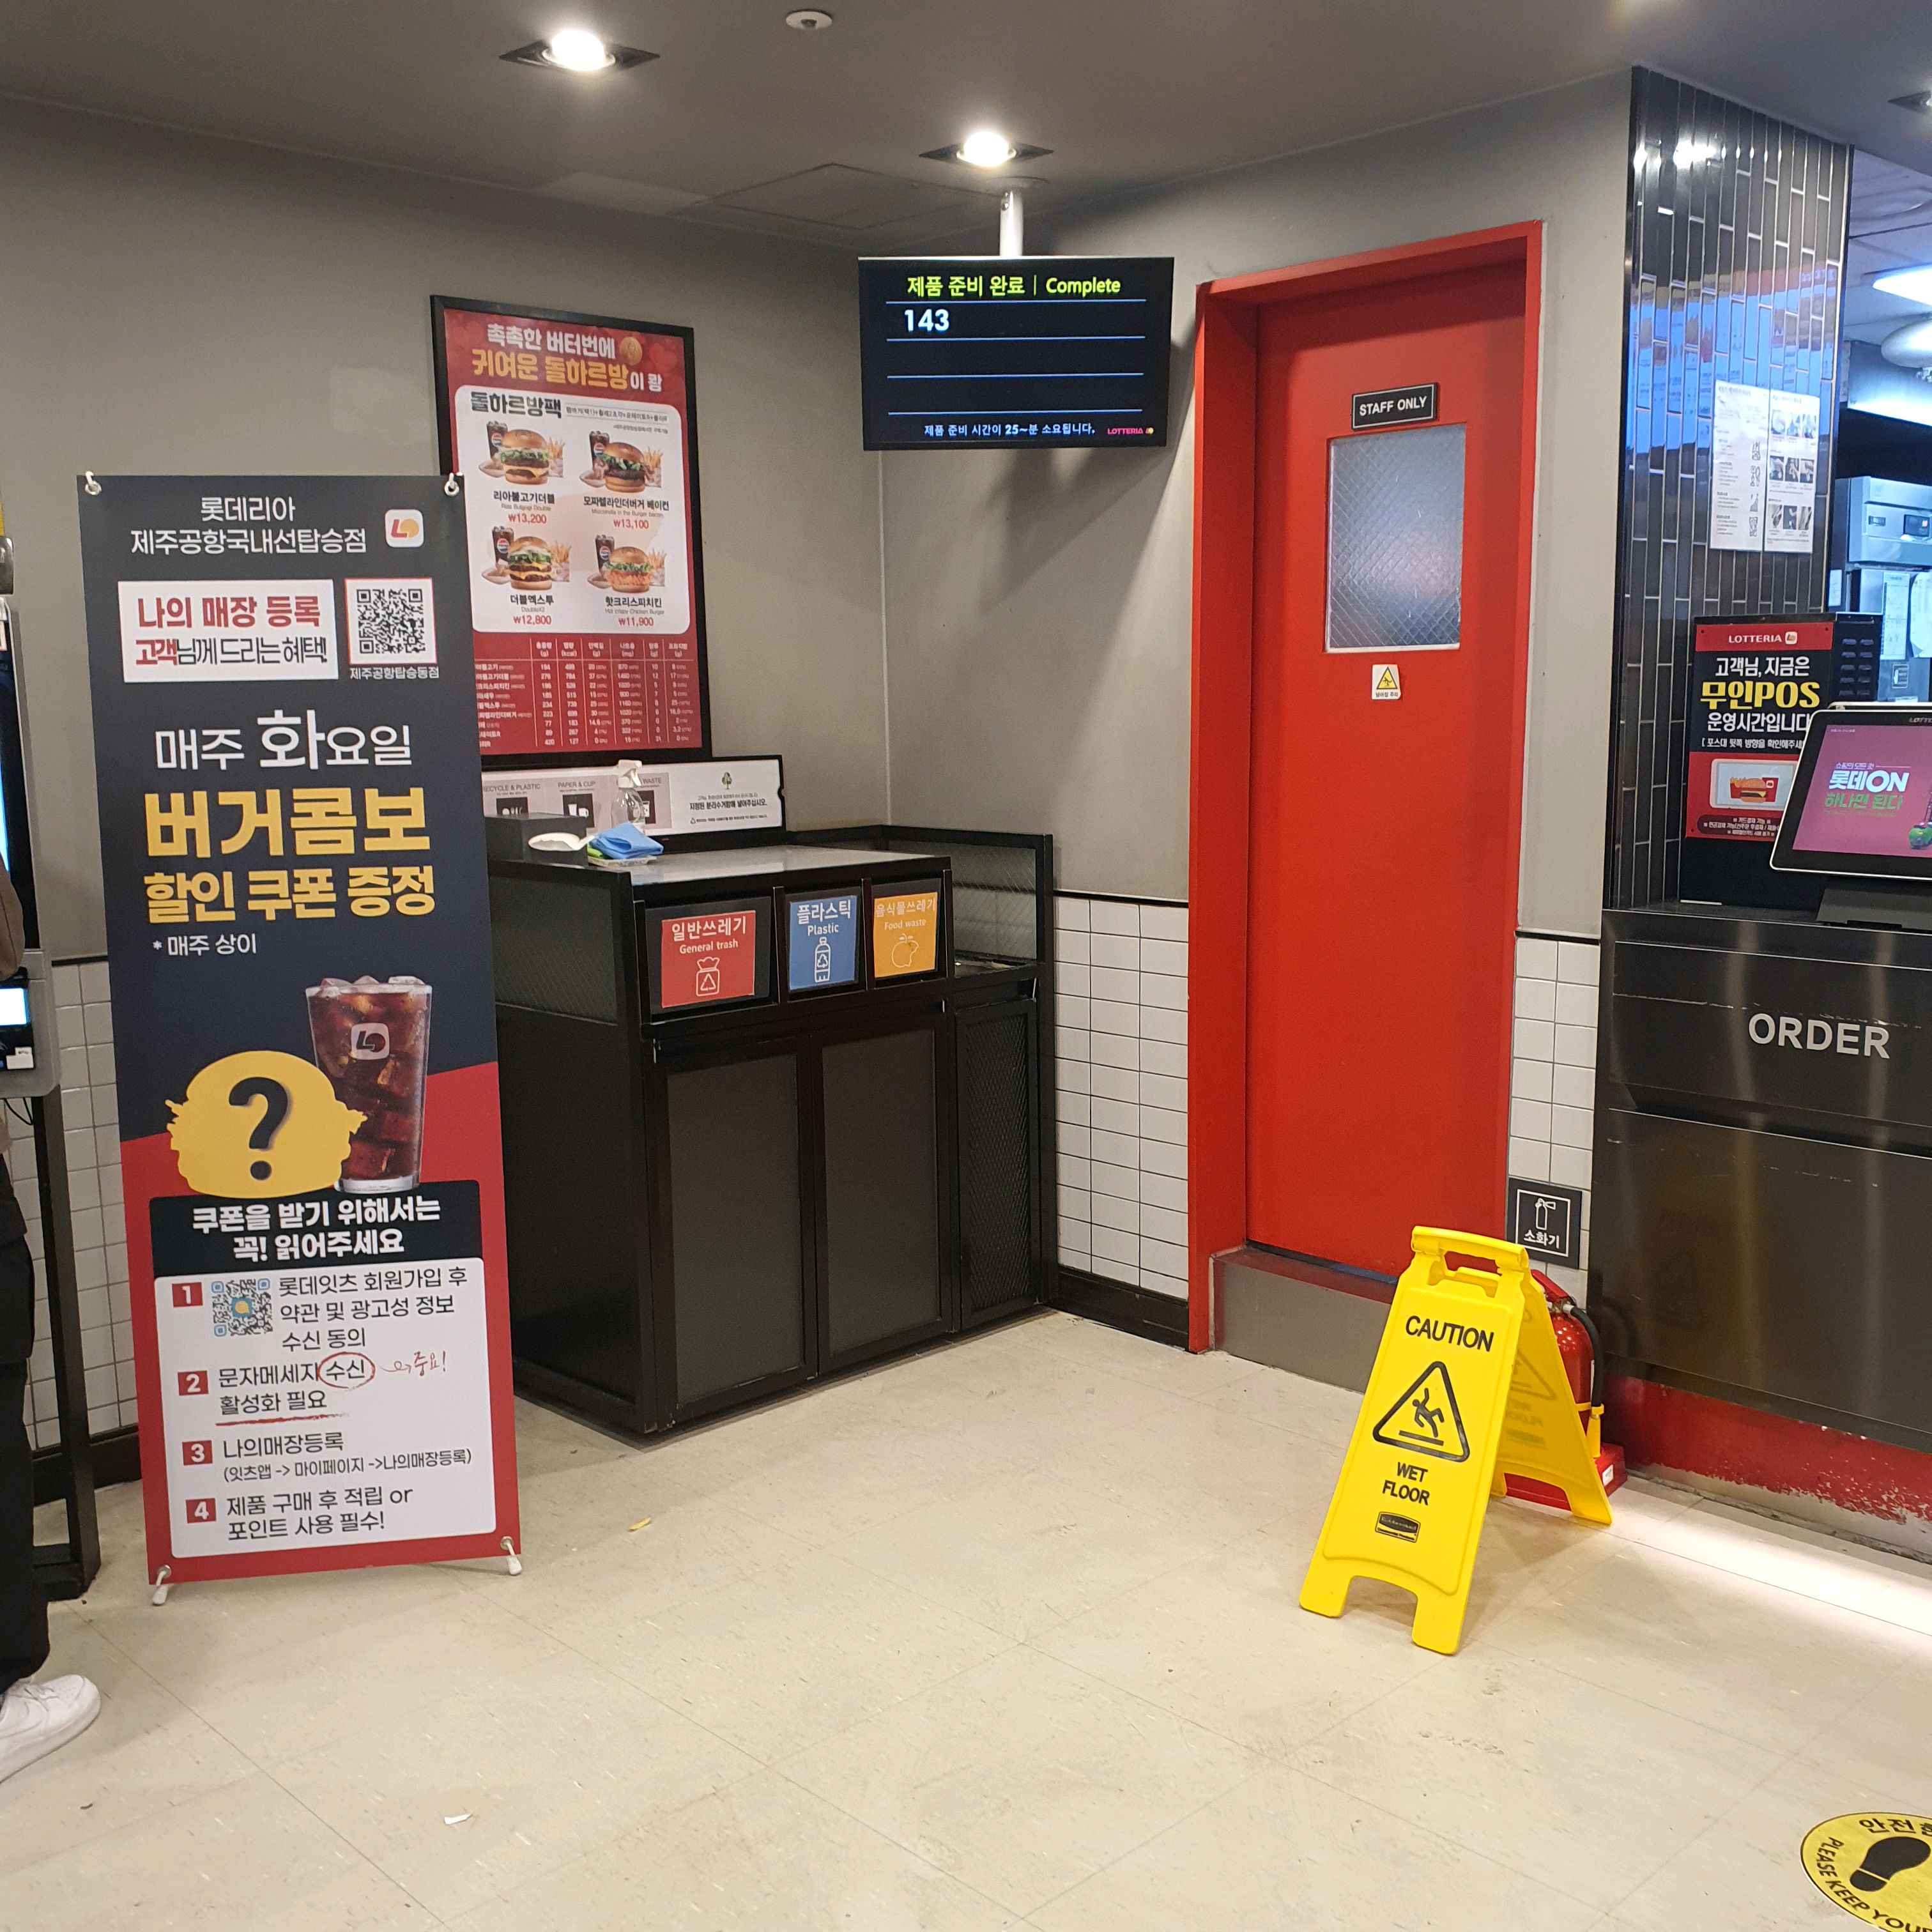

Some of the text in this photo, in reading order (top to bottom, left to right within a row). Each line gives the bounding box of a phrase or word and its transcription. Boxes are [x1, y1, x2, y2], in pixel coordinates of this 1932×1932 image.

[907, 275, 1121, 298] 제품 준비 완료 Complete
[904, 309, 950, 333] 143
[487, 323, 615, 360] 촉촉한 버터번에
[471, 348, 539, 381] 귀여운
[544, 355, 644, 390] 돌하르방이
[470, 390, 562, 418] 돌하르방팩
[1359, 395, 1427, 417] STAFF ONLY
[924, 425, 945, 437] 제품
[948, 424, 968, 437] 준비
[972, 424, 1001, 436] 시간이
[1042, 423, 1095, 436] 소요됩니다.
[1107, 427, 1144, 435] LOTTERIA
[201, 496, 295, 523] 롯데리아
[493, 490, 555, 504] 리아불고기더블
[131, 528, 366, 554] 제주공항국내선탑승점
[138, 596, 320, 628] 나의 매장 등록
[135, 637, 217, 666] 고객님께
[1729, 634, 1782, 644] LOTTERIA
[1715, 656, 1810, 678] 고객님, 지금은
[1700, 680, 1820, 710] 무인POS
[155, 709, 412, 770] 매주 화요일
[1707, 738, 1728, 747] 포스대
[1745, 739, 1765, 749] 방향을
[1767, 739, 1804, 749] 확인해주세
[1829, 770, 1909, 792] 롯데ON
[1825, 792, 1903, 810] 하나면 된다
[144, 787, 430, 858] 버거콤보
[144, 865, 435, 923] 할인 쿠폰 증정
[797, 900, 851, 925] 플라스틱
[877, 898, 935, 917] 음식물쓰레기
[671, 916, 747, 942] 일반쓰레기
[808, 923, 839, 936] Plastic
[884, 920, 903, 930] Food
[167, 933, 256, 956] 매주 상이
[679, 938, 739, 955] General trash
[1749, 1013, 1890, 1059] ORDER
[192, 1195, 441, 1234] 쿠폰을 받기 위해서는
[233, 1229, 404, 1262] 꼭! 읽어주세요
[1524, 1229, 1560, 1249] 소화기
[279, 1273, 358, 1296] 롯데잇츠
[364, 1268, 441, 1292] 회원가입
[448, 1266, 467, 1285] 후
[280, 1295, 455, 1324] 약관 및 광고성 정보
[282, 1327, 366, 1352] 수신 동의
[1406, 1315, 1494, 1352] CAUTION
[186, 1360, 365, 1393] 2 문자메세지 수신
[220, 1390, 327, 1415] 활성화 필요
[191, 1432, 344, 1463] 3 나의매장등록
[224, 1463, 272, 1483] (잇츠앱
[295, 1457, 365, 1477] 마이페이지
[1397, 1462, 1429, 1483] WET
[194, 1486, 413, 1520] 4 제품 구매 후 적립 or
[1382, 1480, 1430, 1506] FLOOR
[227, 1510, 385, 1541] 포인트 사용 필수!
[1816, 1837, 1844, 1877] PLEASE
[1825, 1880, 1870, 1910] KEEP
